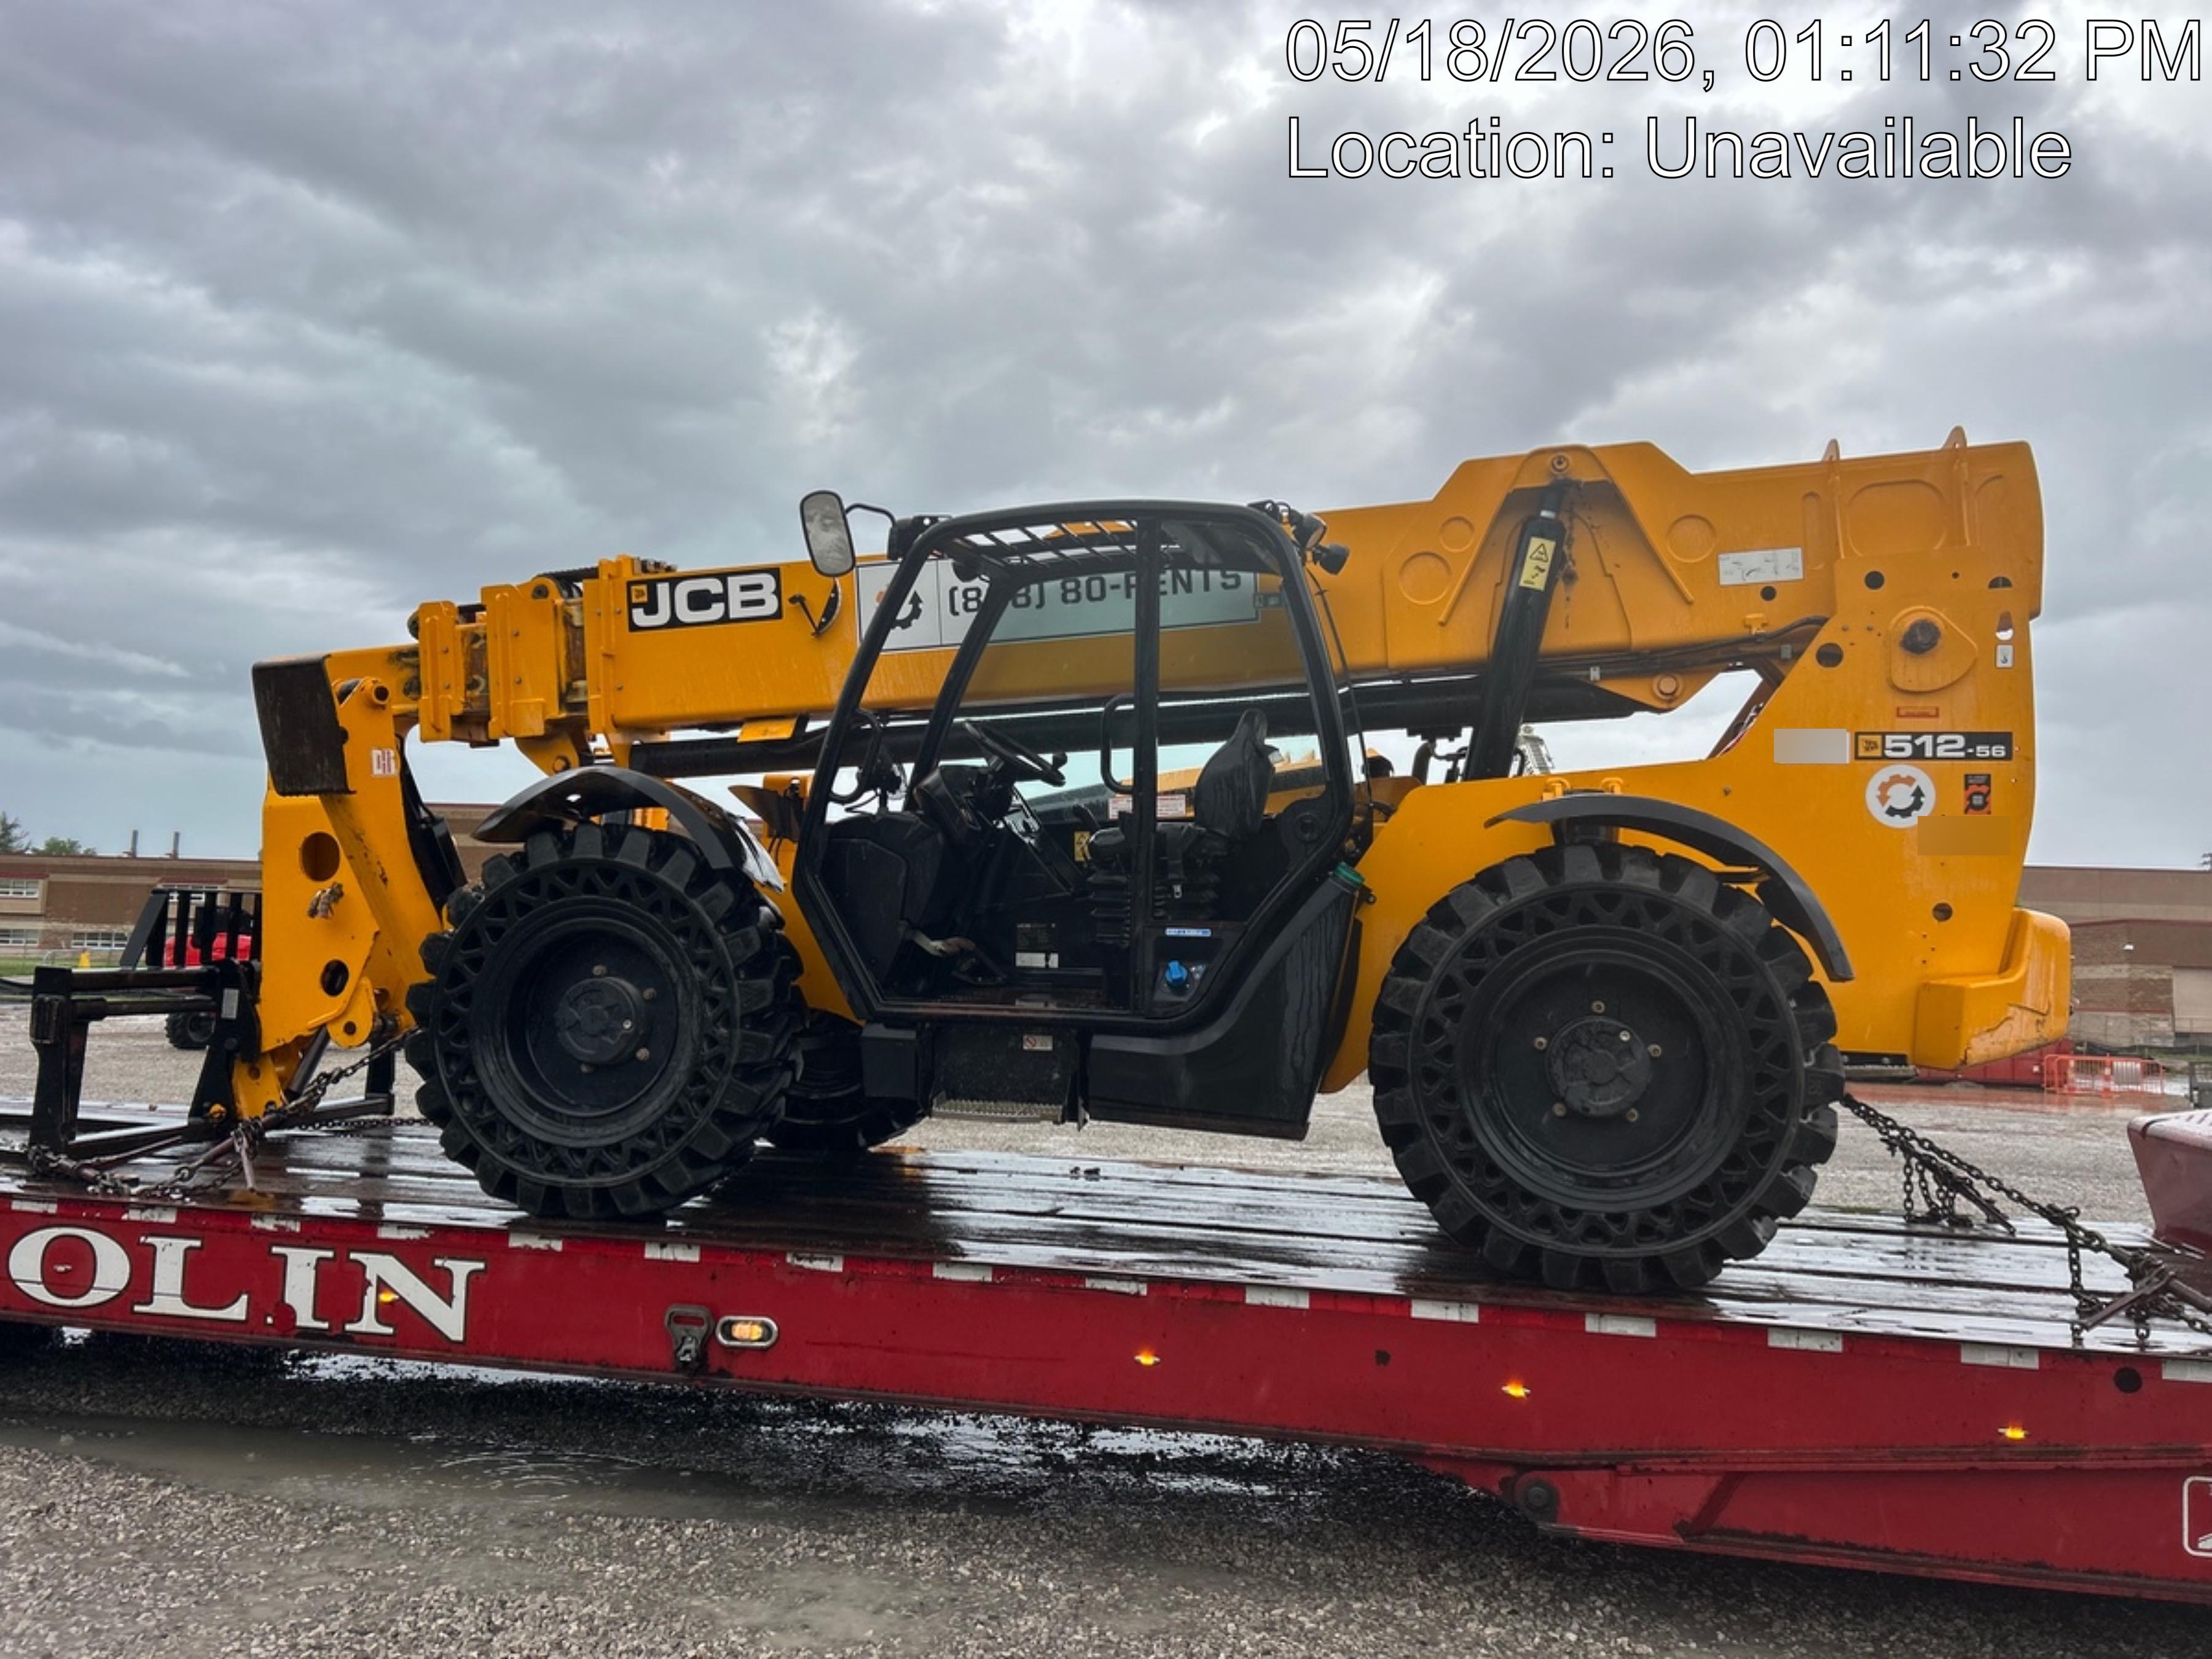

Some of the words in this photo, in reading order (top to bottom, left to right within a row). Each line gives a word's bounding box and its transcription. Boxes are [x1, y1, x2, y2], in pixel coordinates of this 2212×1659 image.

[631, 573, 779, 627] JCB
[949, 584, 1045, 616] (88)
[1883, 734, 2007, 758] 512-56
[8, 1228, 487, 1343] OLIN
